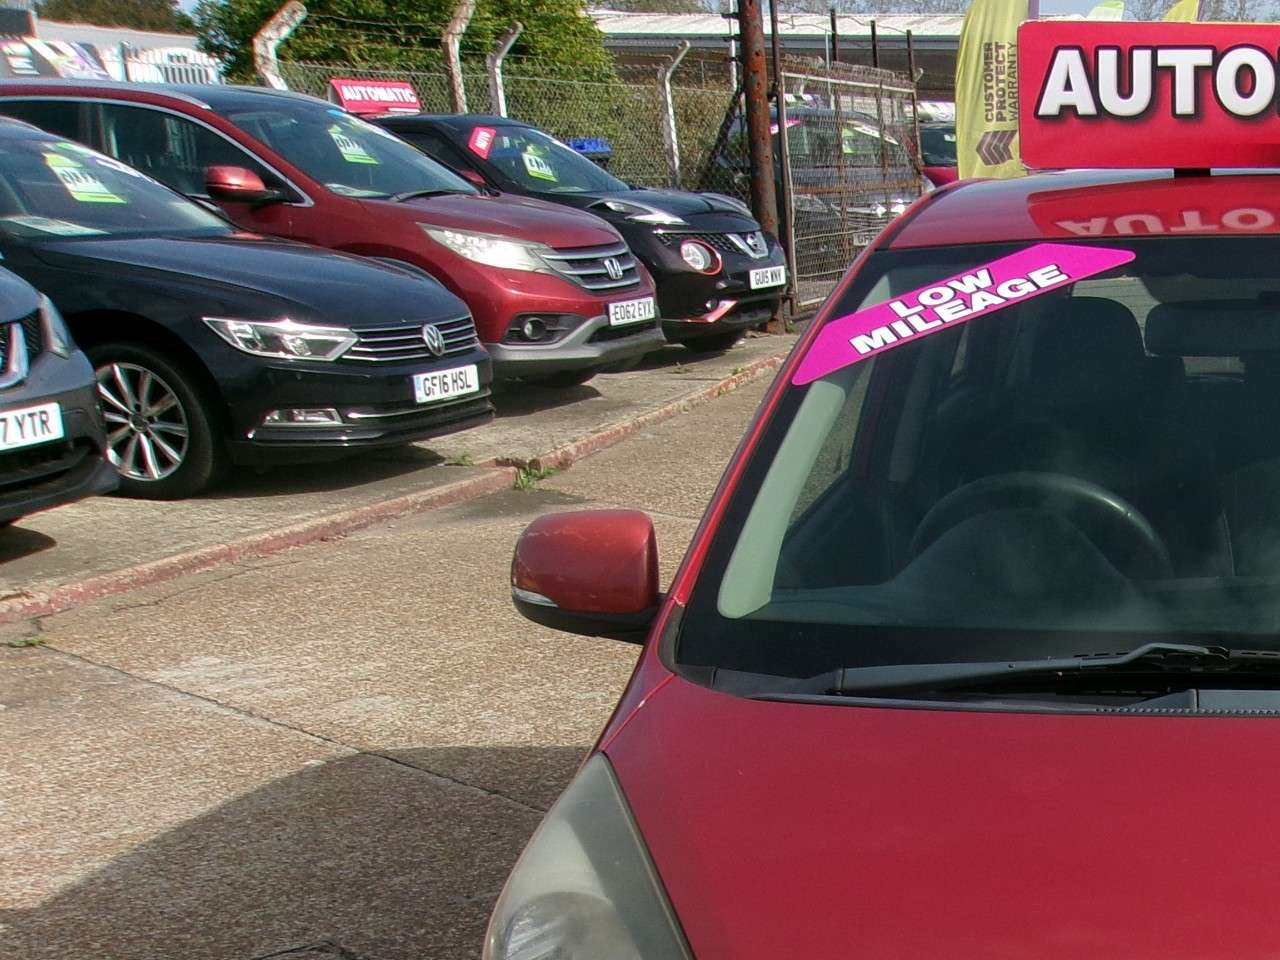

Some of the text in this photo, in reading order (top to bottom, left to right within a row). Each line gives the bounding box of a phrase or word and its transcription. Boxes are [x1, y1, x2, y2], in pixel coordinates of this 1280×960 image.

[341, 85, 417, 102] AUTOMATIC
[984, 42, 994, 122] CUSTOMER
[995, 41, 1007, 122] PROTECT
[1007, 41, 1018, 121] WARRANTY
[848, 264, 1071, 355] MILEAGE
[888, 268, 994, 319] LOW
[423, 369, 472, 396] GF16 HSL
[14, 410, 52, 439] YTR
